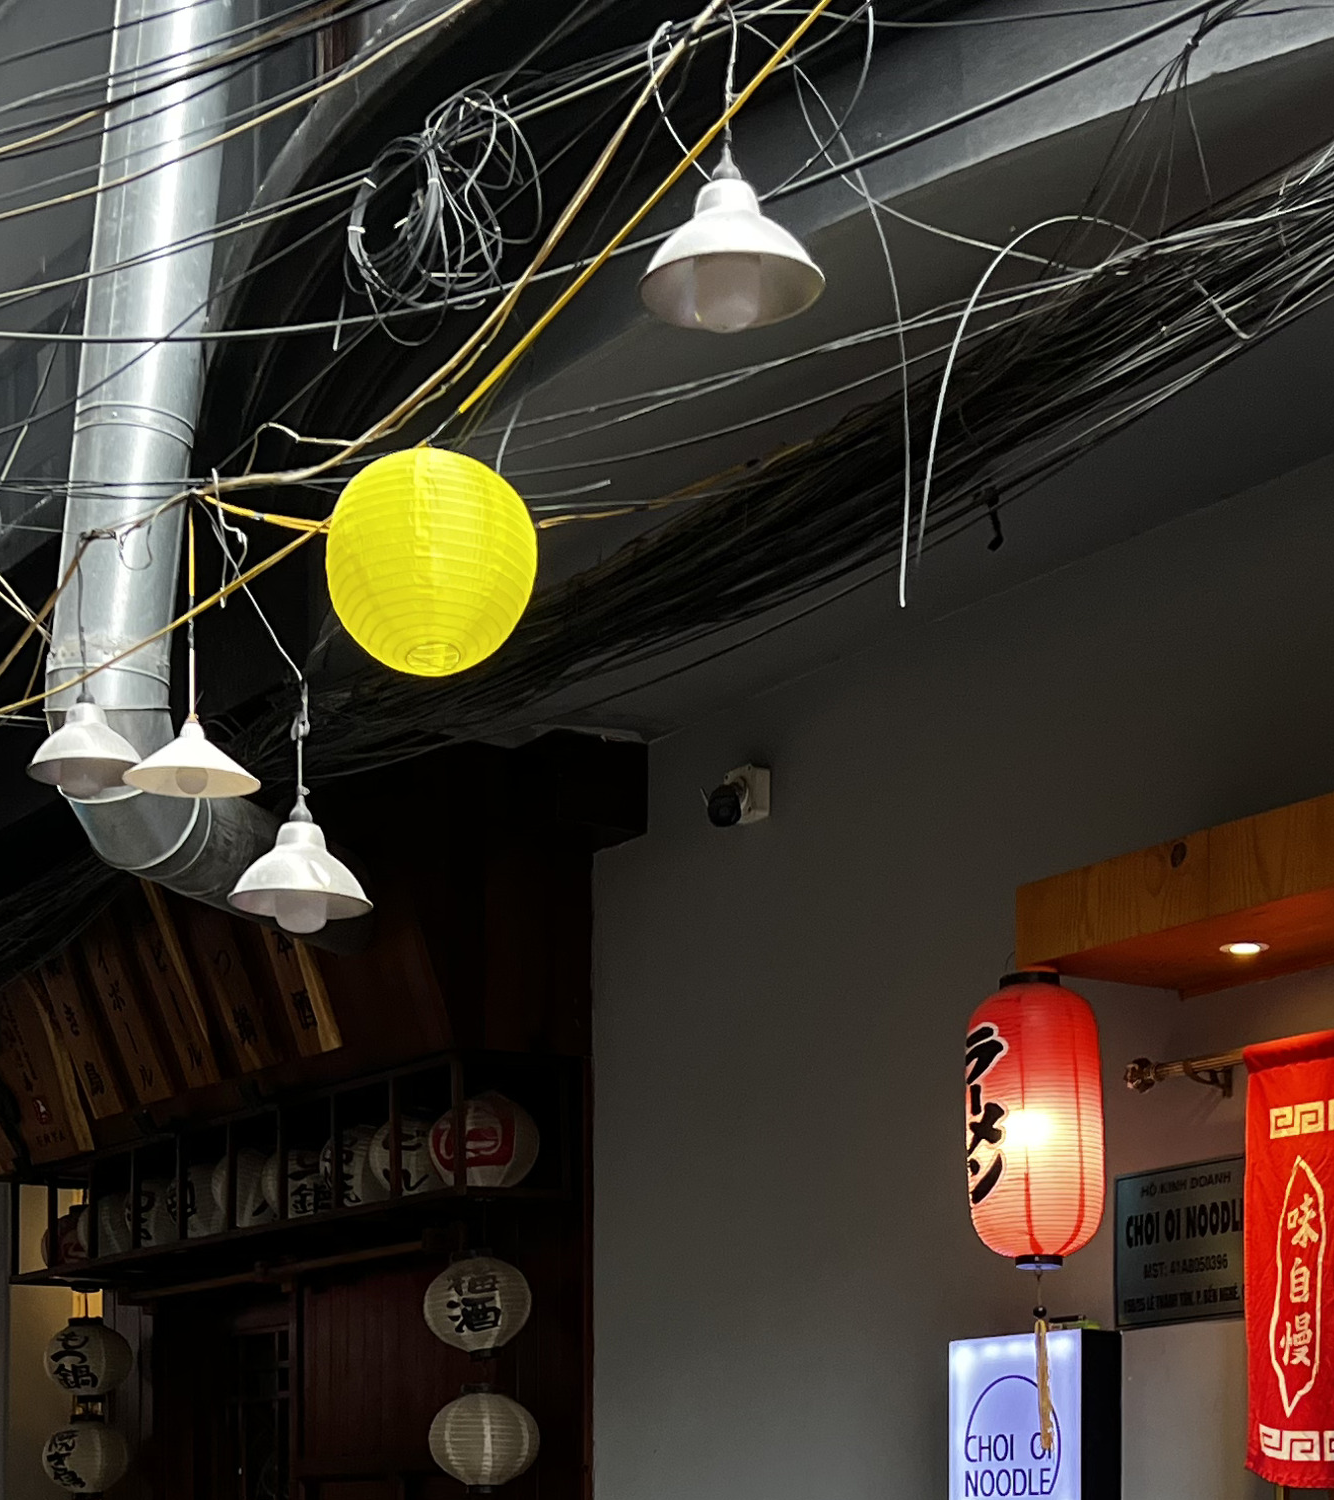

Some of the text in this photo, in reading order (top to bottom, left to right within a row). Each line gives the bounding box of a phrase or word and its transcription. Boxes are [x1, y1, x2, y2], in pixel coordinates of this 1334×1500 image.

[1190, 1171, 1231, 1190] DOANH
[1125, 1211, 1160, 1248] CHOI
[1164, 1208, 1181, 1243] OI
[1278, 1192, 1321, 1369] 味自慢
[965, 1433, 1014, 1462] CHOI
[965, 1470, 1052, 1497] NOODLE
